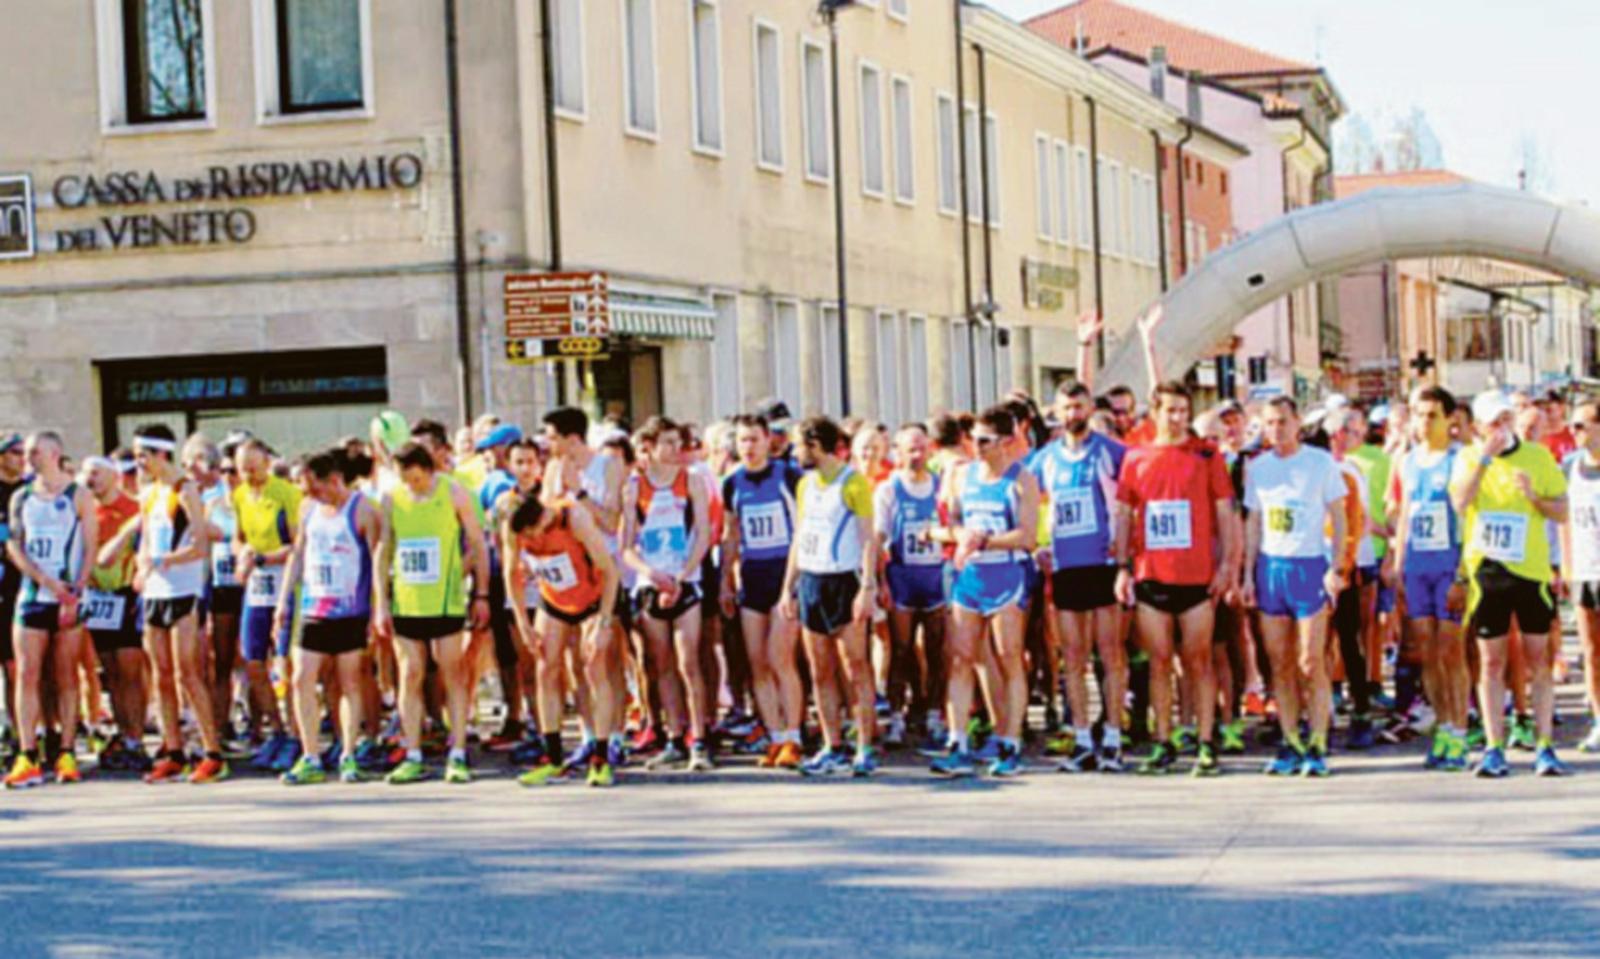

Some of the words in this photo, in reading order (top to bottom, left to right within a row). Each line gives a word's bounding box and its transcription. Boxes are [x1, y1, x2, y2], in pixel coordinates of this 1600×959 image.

[52, 169, 166, 210] CASSA
[207, 153, 422, 200] RISPARMIO
[100, 207, 256, 249] VENETO
